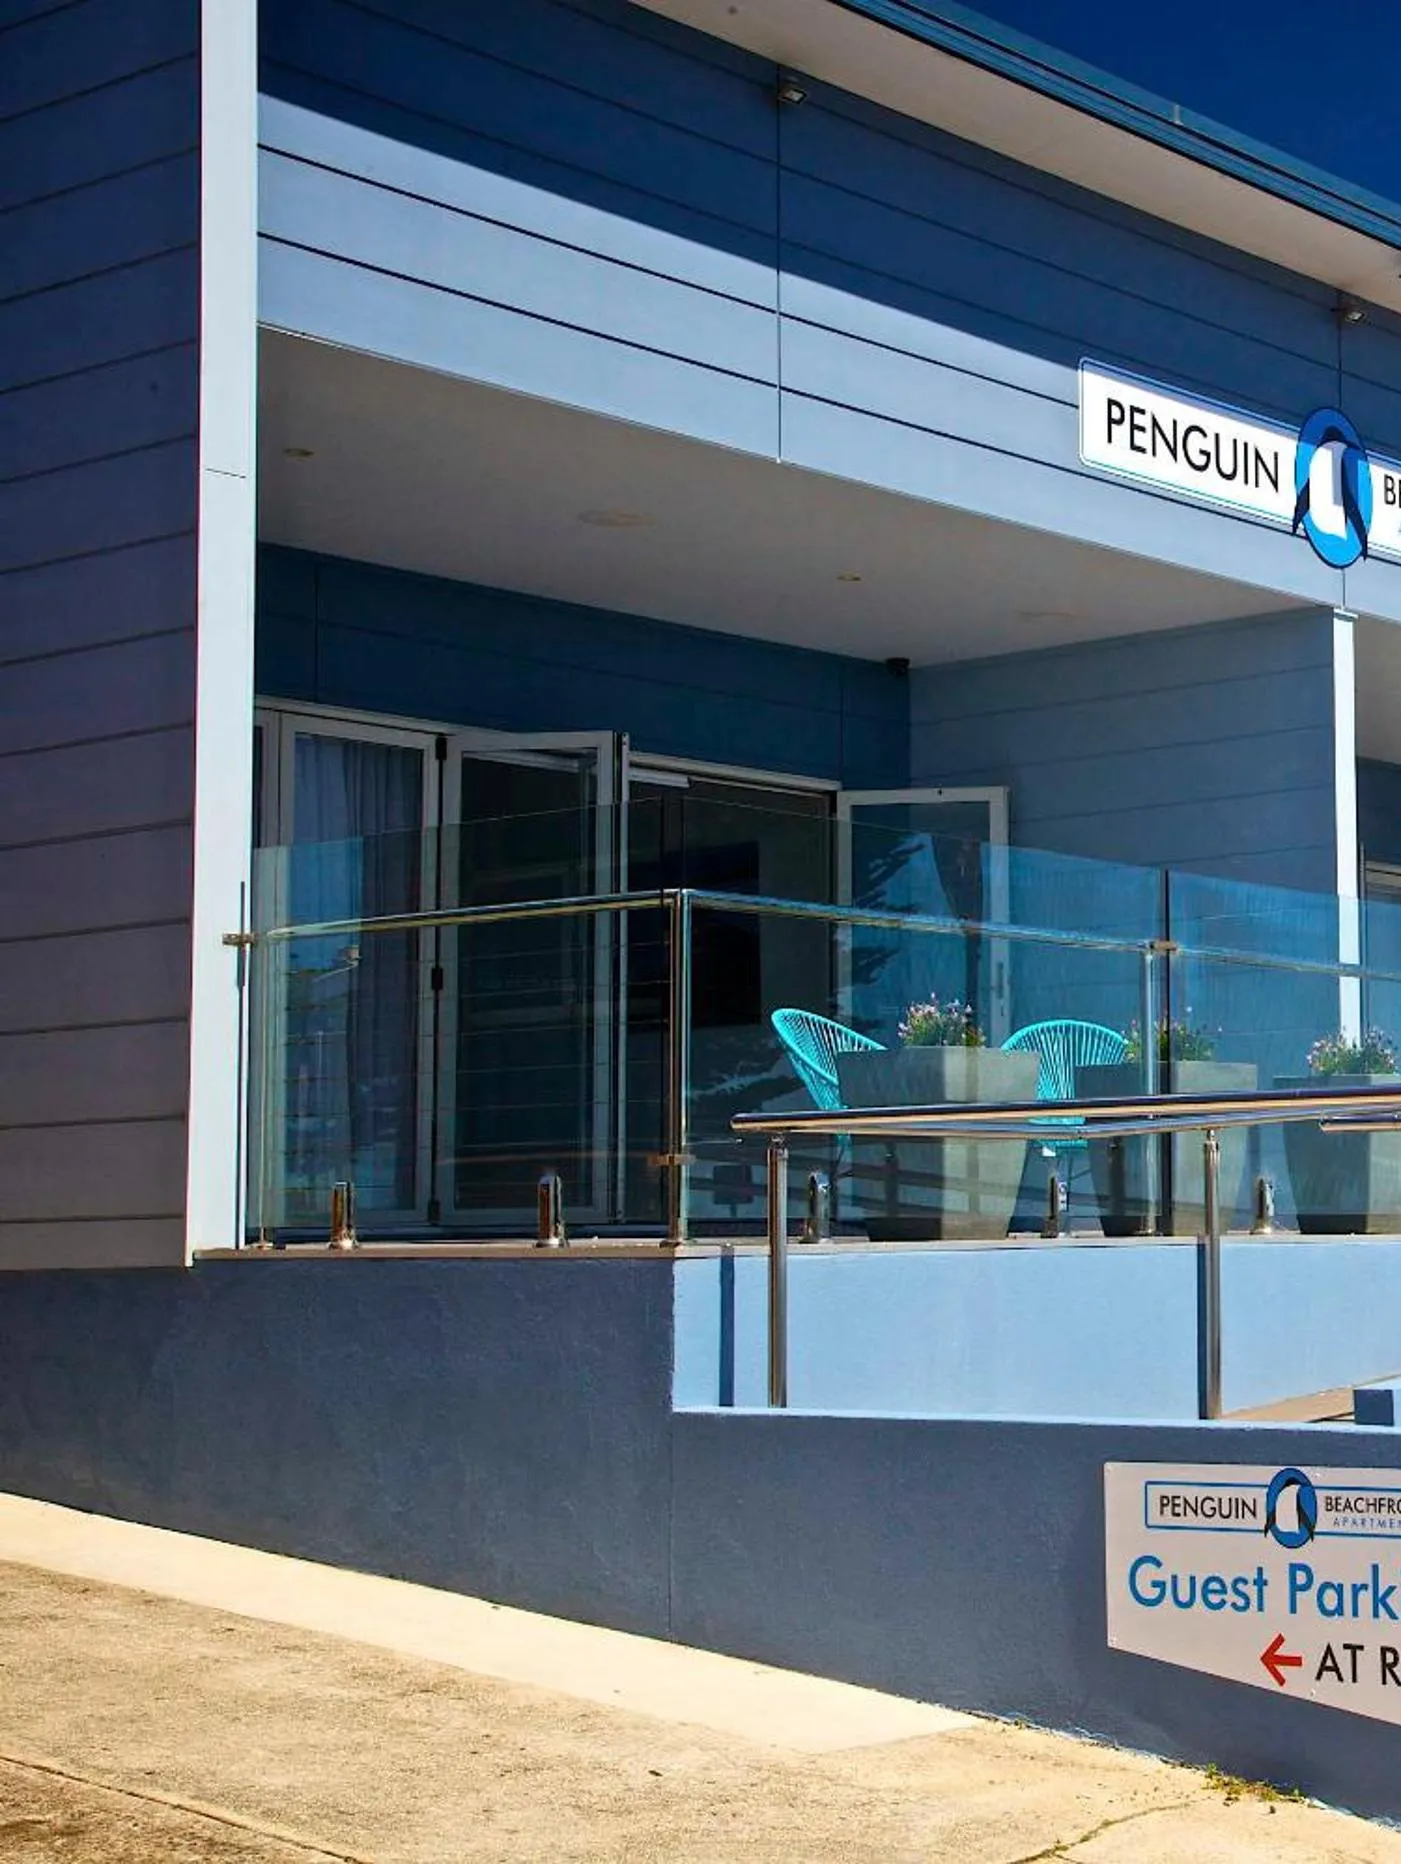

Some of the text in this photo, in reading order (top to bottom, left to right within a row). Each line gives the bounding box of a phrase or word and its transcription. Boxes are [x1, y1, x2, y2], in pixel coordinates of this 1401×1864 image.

[1106, 396, 1280, 493] PENGUIN
[1159, 1495, 1257, 1520] PENGUIN
[1128, 1555, 1268, 1613] Guest
[1315, 1642, 1365, 1684] AT
